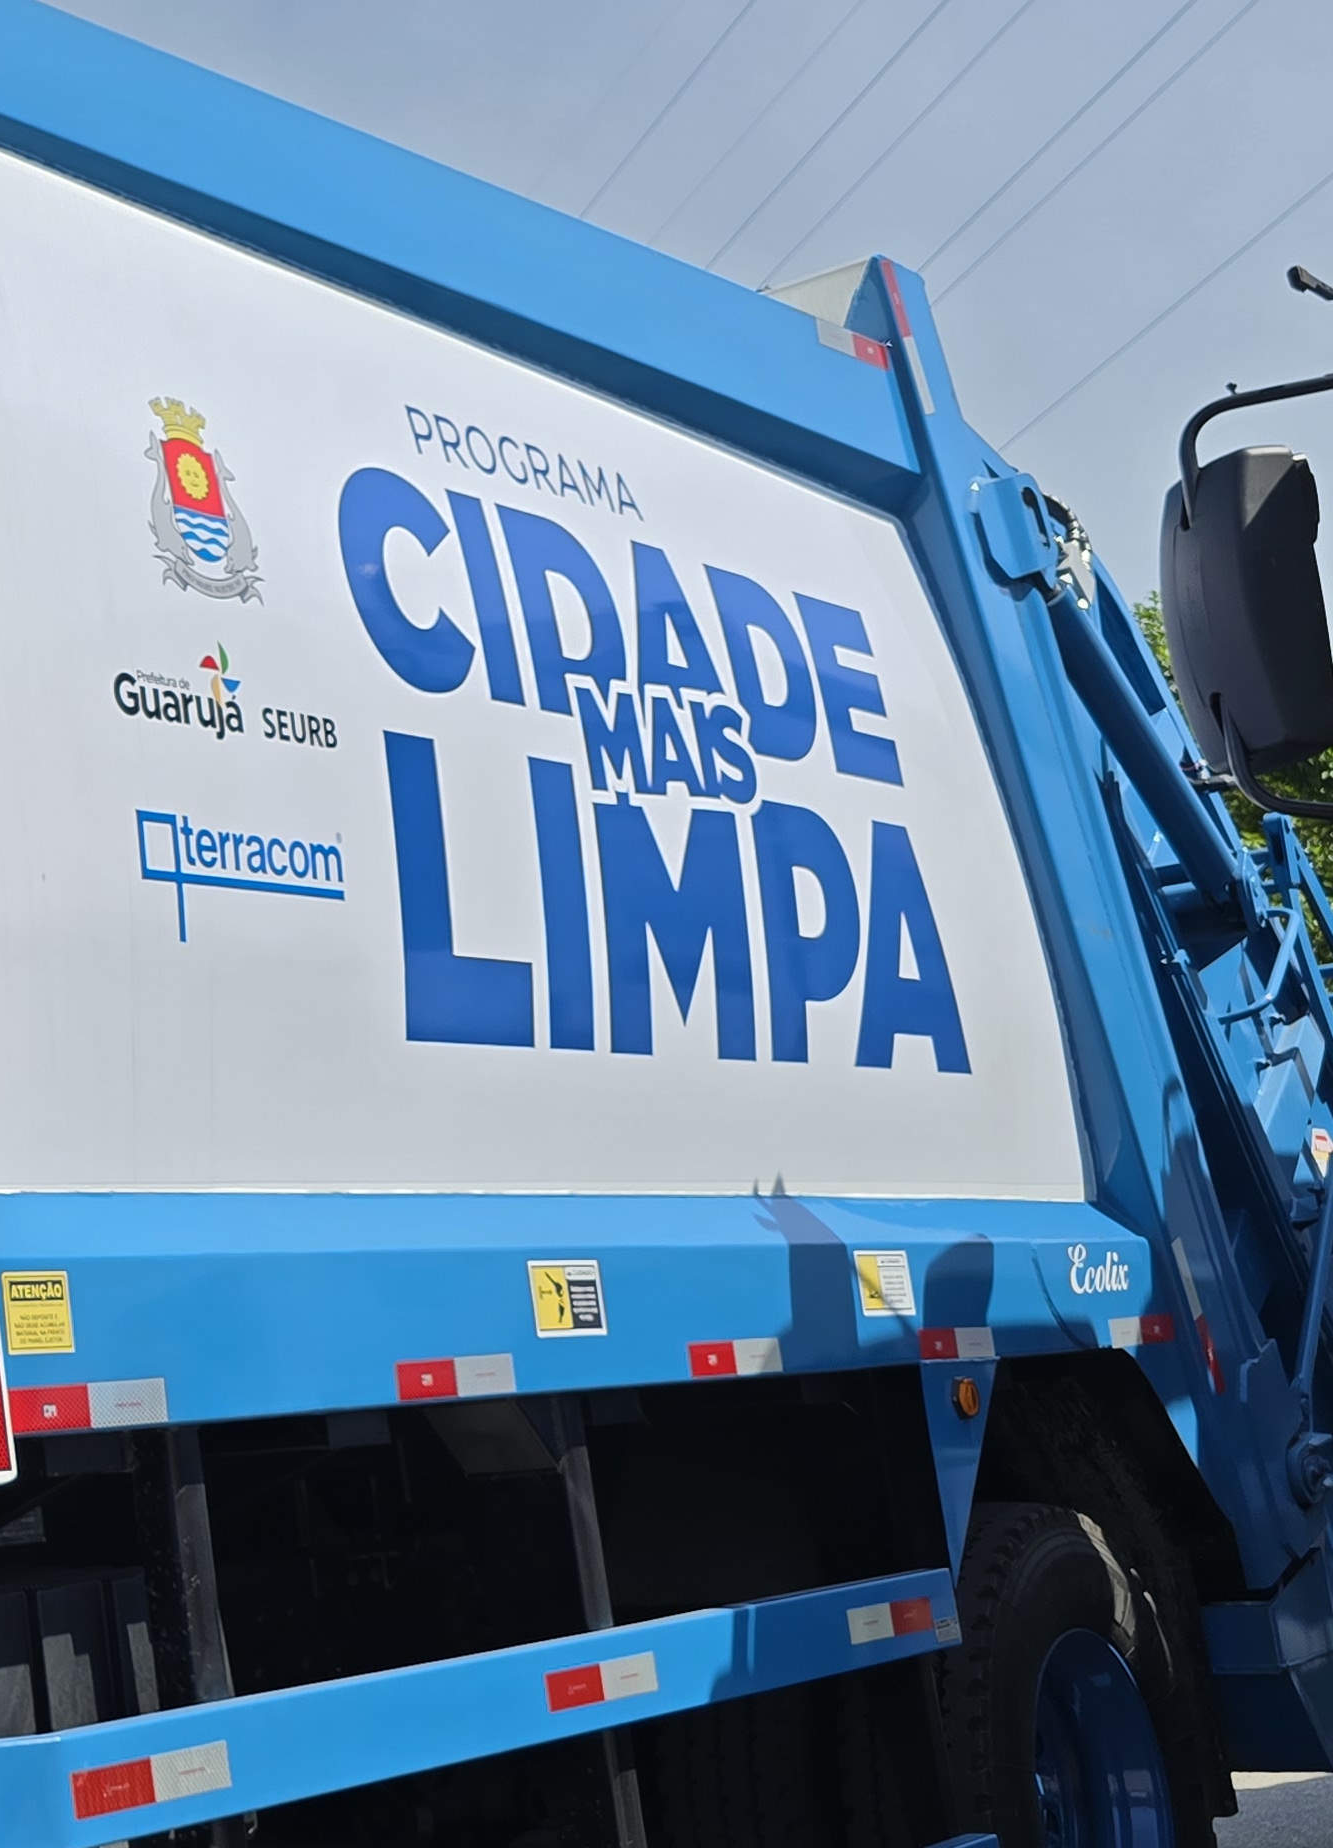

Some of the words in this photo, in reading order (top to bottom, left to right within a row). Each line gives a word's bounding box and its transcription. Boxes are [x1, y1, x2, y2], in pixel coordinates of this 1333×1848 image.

[404, 405, 644, 520] PROGRAMA
[338, 467, 904, 787] CIDADE
[114, 672, 244, 740] Guarujá
[262, 707, 337, 748] SEURB
[136, 670, 177, 689] Prefeitura
[179, 678, 190, 690] de
[571, 683, 757, 803] MAIS
[180, 815, 343, 883] terracom
[383, 730, 972, 1074] LIMPA
[11, 1281, 62, 1300] ATENÇÃO
[1067, 1243, 1129, 1294] Ecolix
